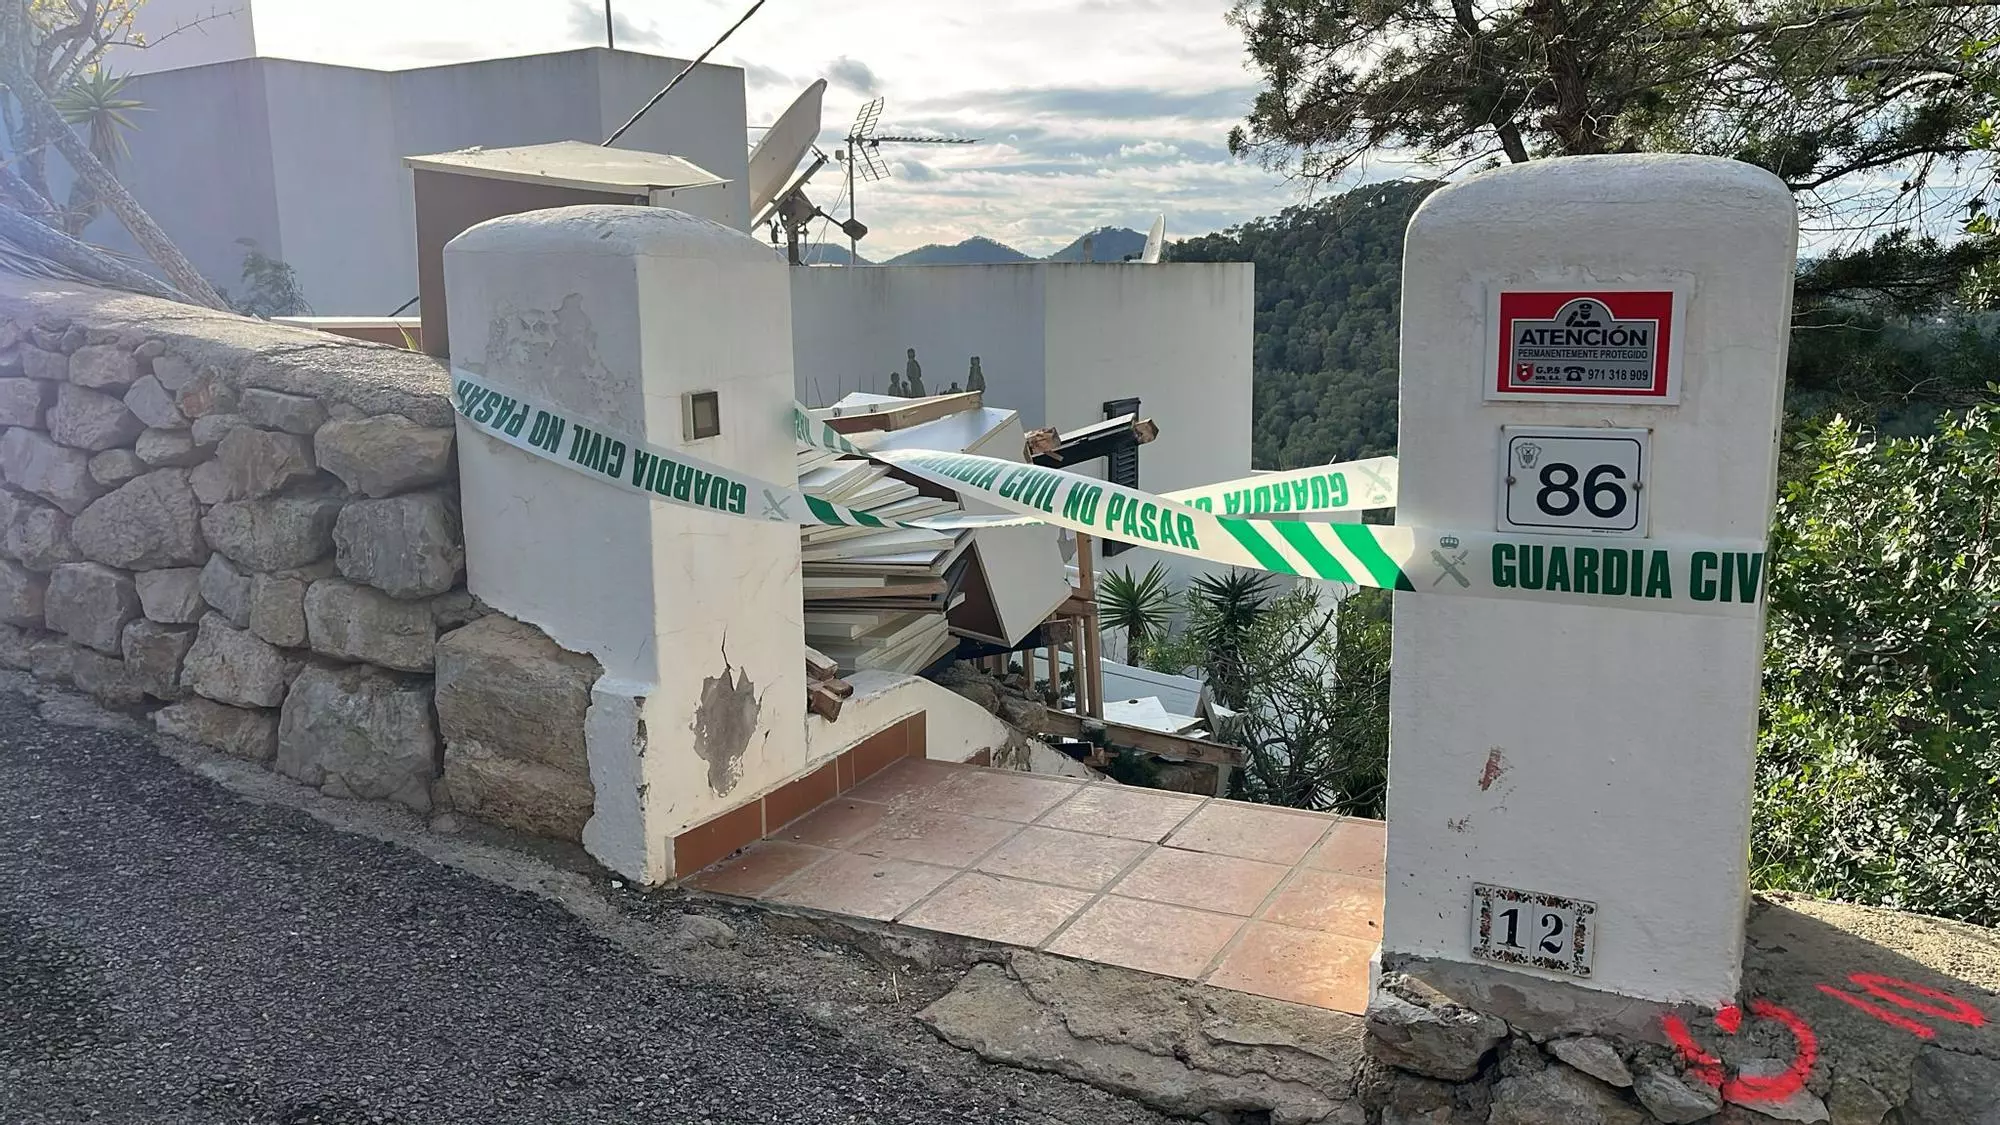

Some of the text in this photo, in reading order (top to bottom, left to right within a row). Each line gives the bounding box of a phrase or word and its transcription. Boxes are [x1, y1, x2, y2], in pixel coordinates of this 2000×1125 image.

[1518, 348, 1648, 360] PERMANENTEMENTE PROTEGIDO
[1520, 325, 1648, 347] ATENCIÓN
[1588, 369, 1648, 381] 971 318 909
[528, 411, 566, 454] NO
[569, 425, 625, 478] CIVIL
[632, 449, 747, 515] GUARDIA
[1223, 472, 1349, 515] GUARDIA
[1536, 462, 1627, 519] 86
[999, 467, 1064, 513] CIVIL
[1063, 481, 1104, 525] NO
[1106, 493, 1200, 551] PASAR
[1492, 543, 1673, 599] GUARDIA
[1496, 909, 1564, 954] 12
